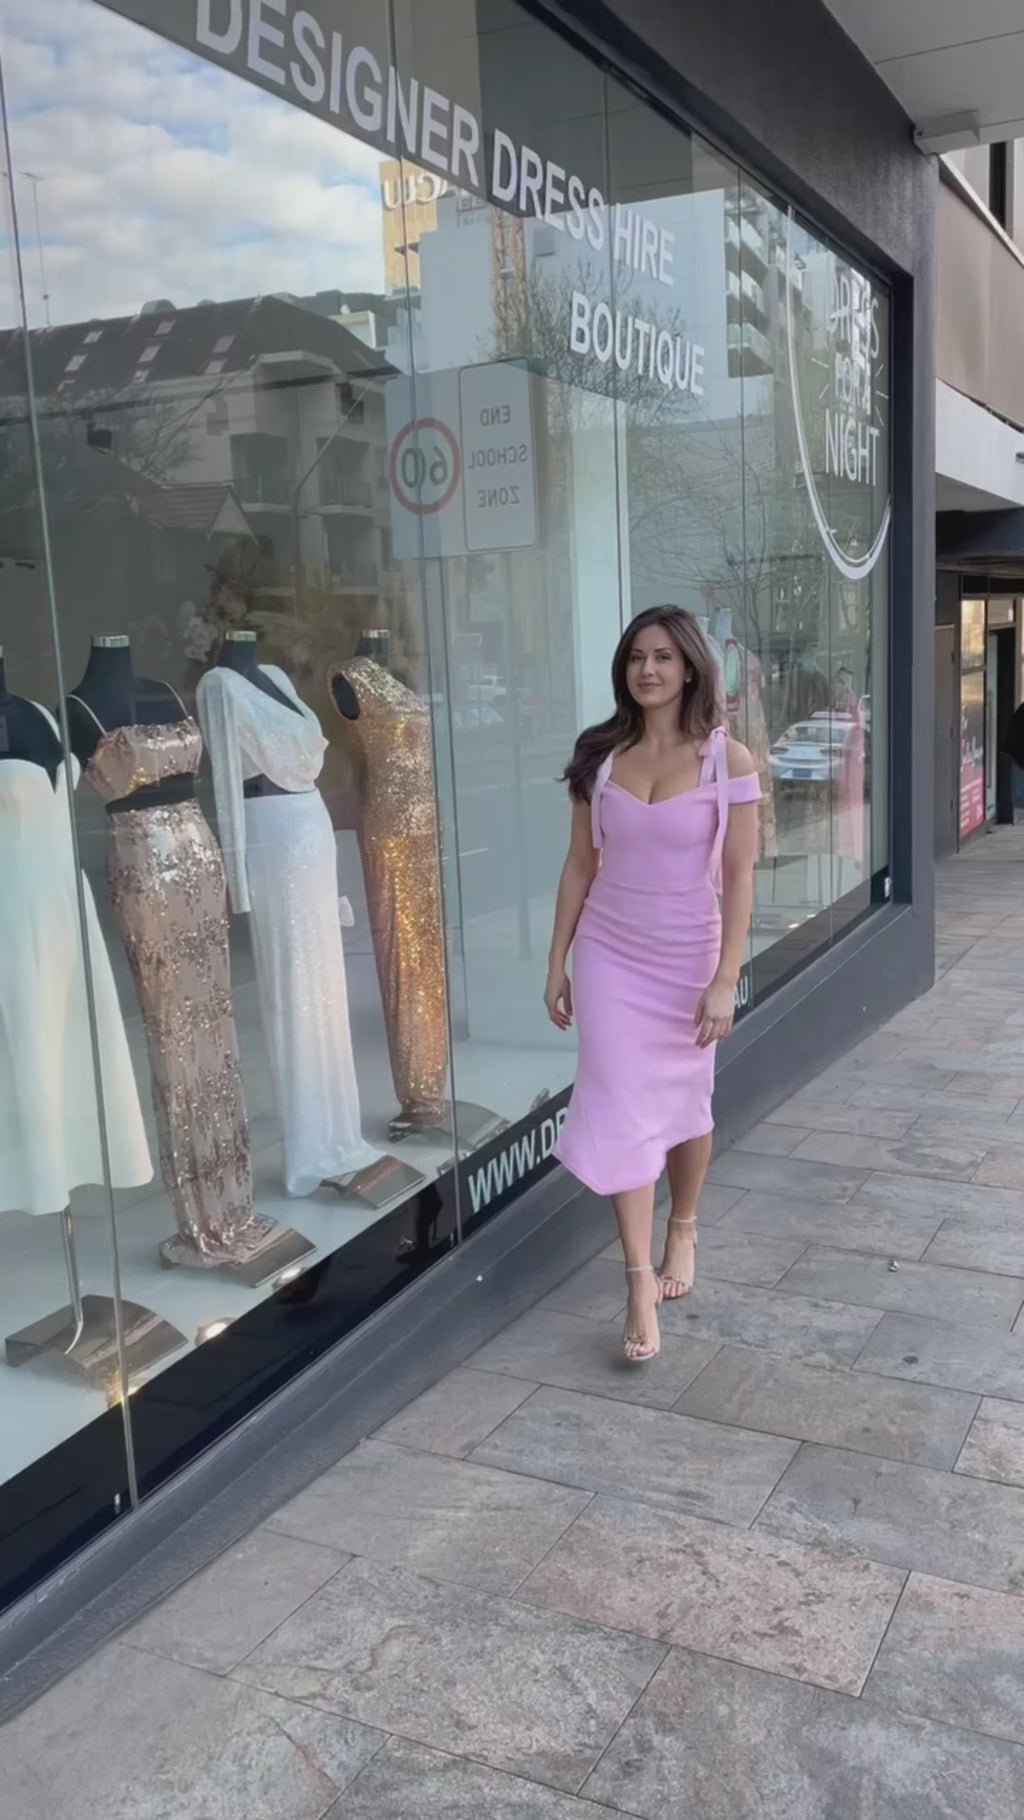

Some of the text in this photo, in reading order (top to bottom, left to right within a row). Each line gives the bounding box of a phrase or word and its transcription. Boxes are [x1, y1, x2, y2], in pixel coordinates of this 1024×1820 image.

[196, 0, 675, 286] DESIGNER DRESS HIRE
[570, 290, 705, 395] BOUTIQUE
[825, 408, 880, 487] NIGHT
